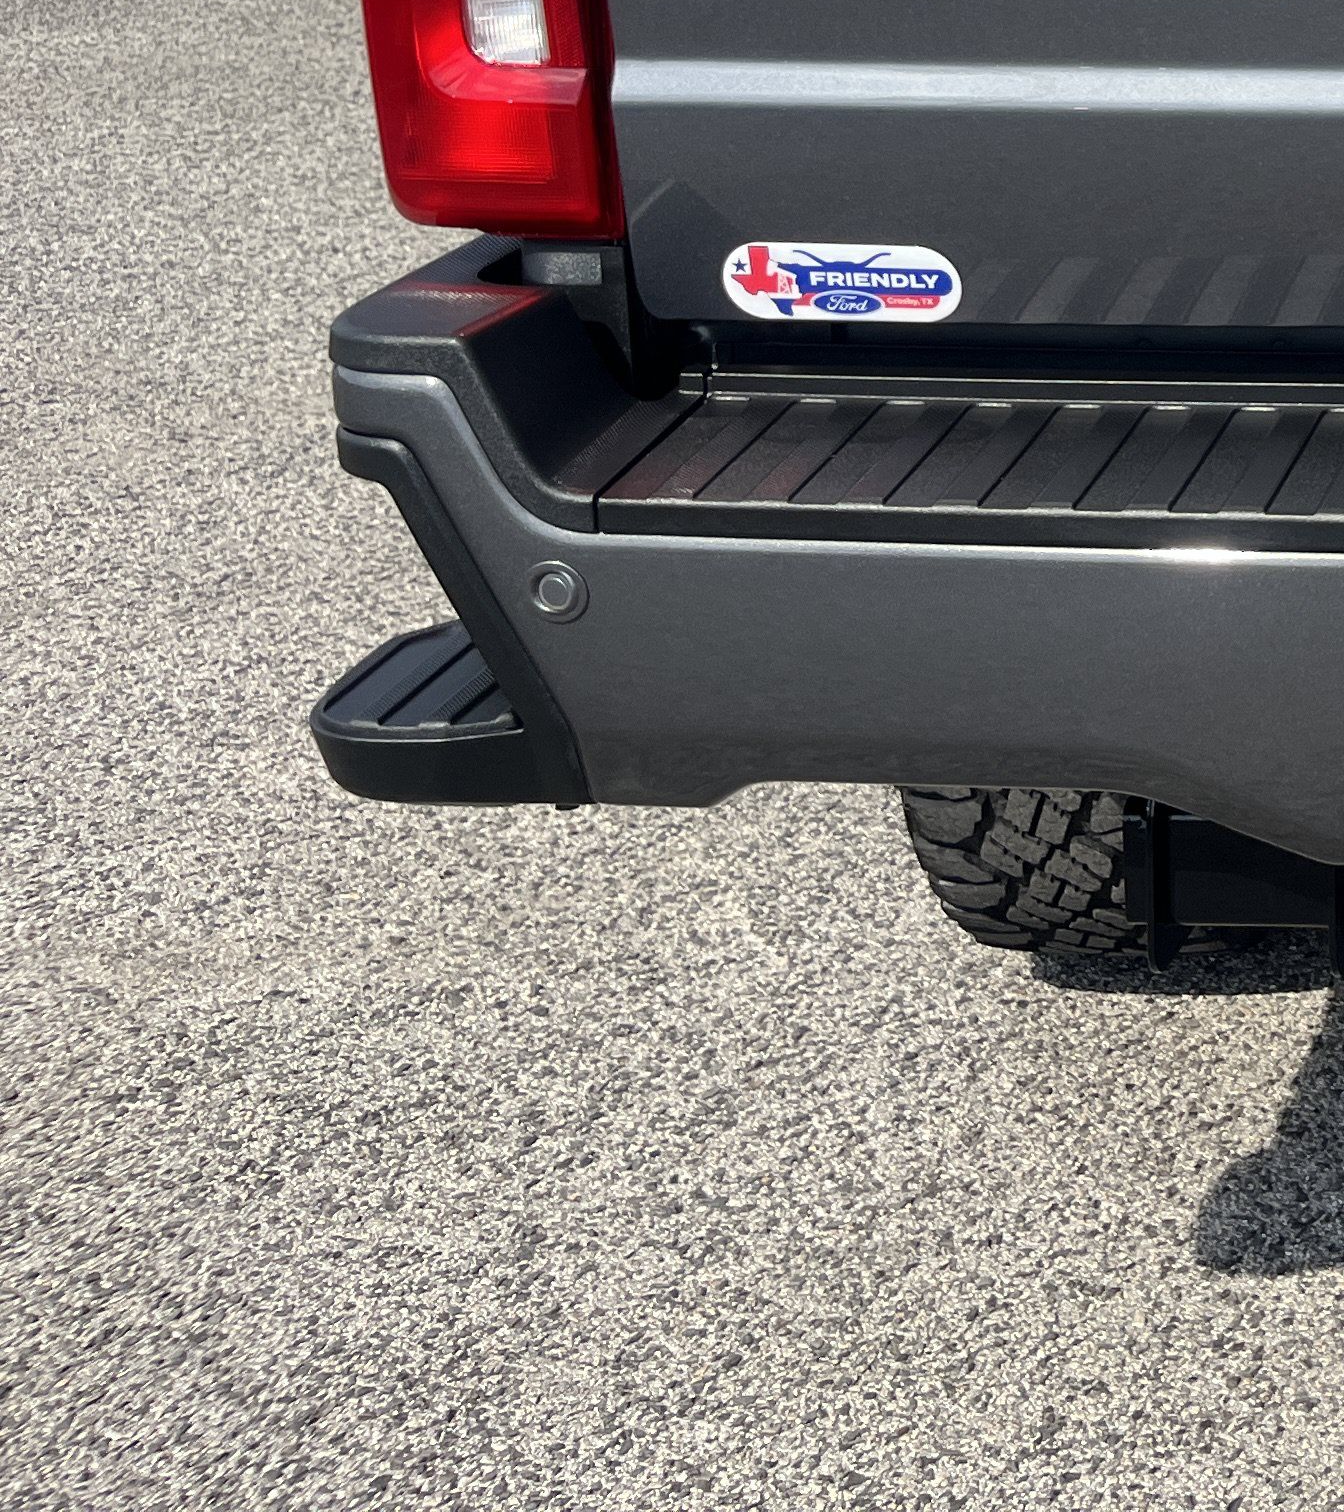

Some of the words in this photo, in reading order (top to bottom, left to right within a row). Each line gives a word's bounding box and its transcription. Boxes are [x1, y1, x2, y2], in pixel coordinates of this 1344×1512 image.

[809, 270, 939, 289] FRIENDLY
[826, 295, 868, 312] Ford
[920, 297, 934, 306] TX
